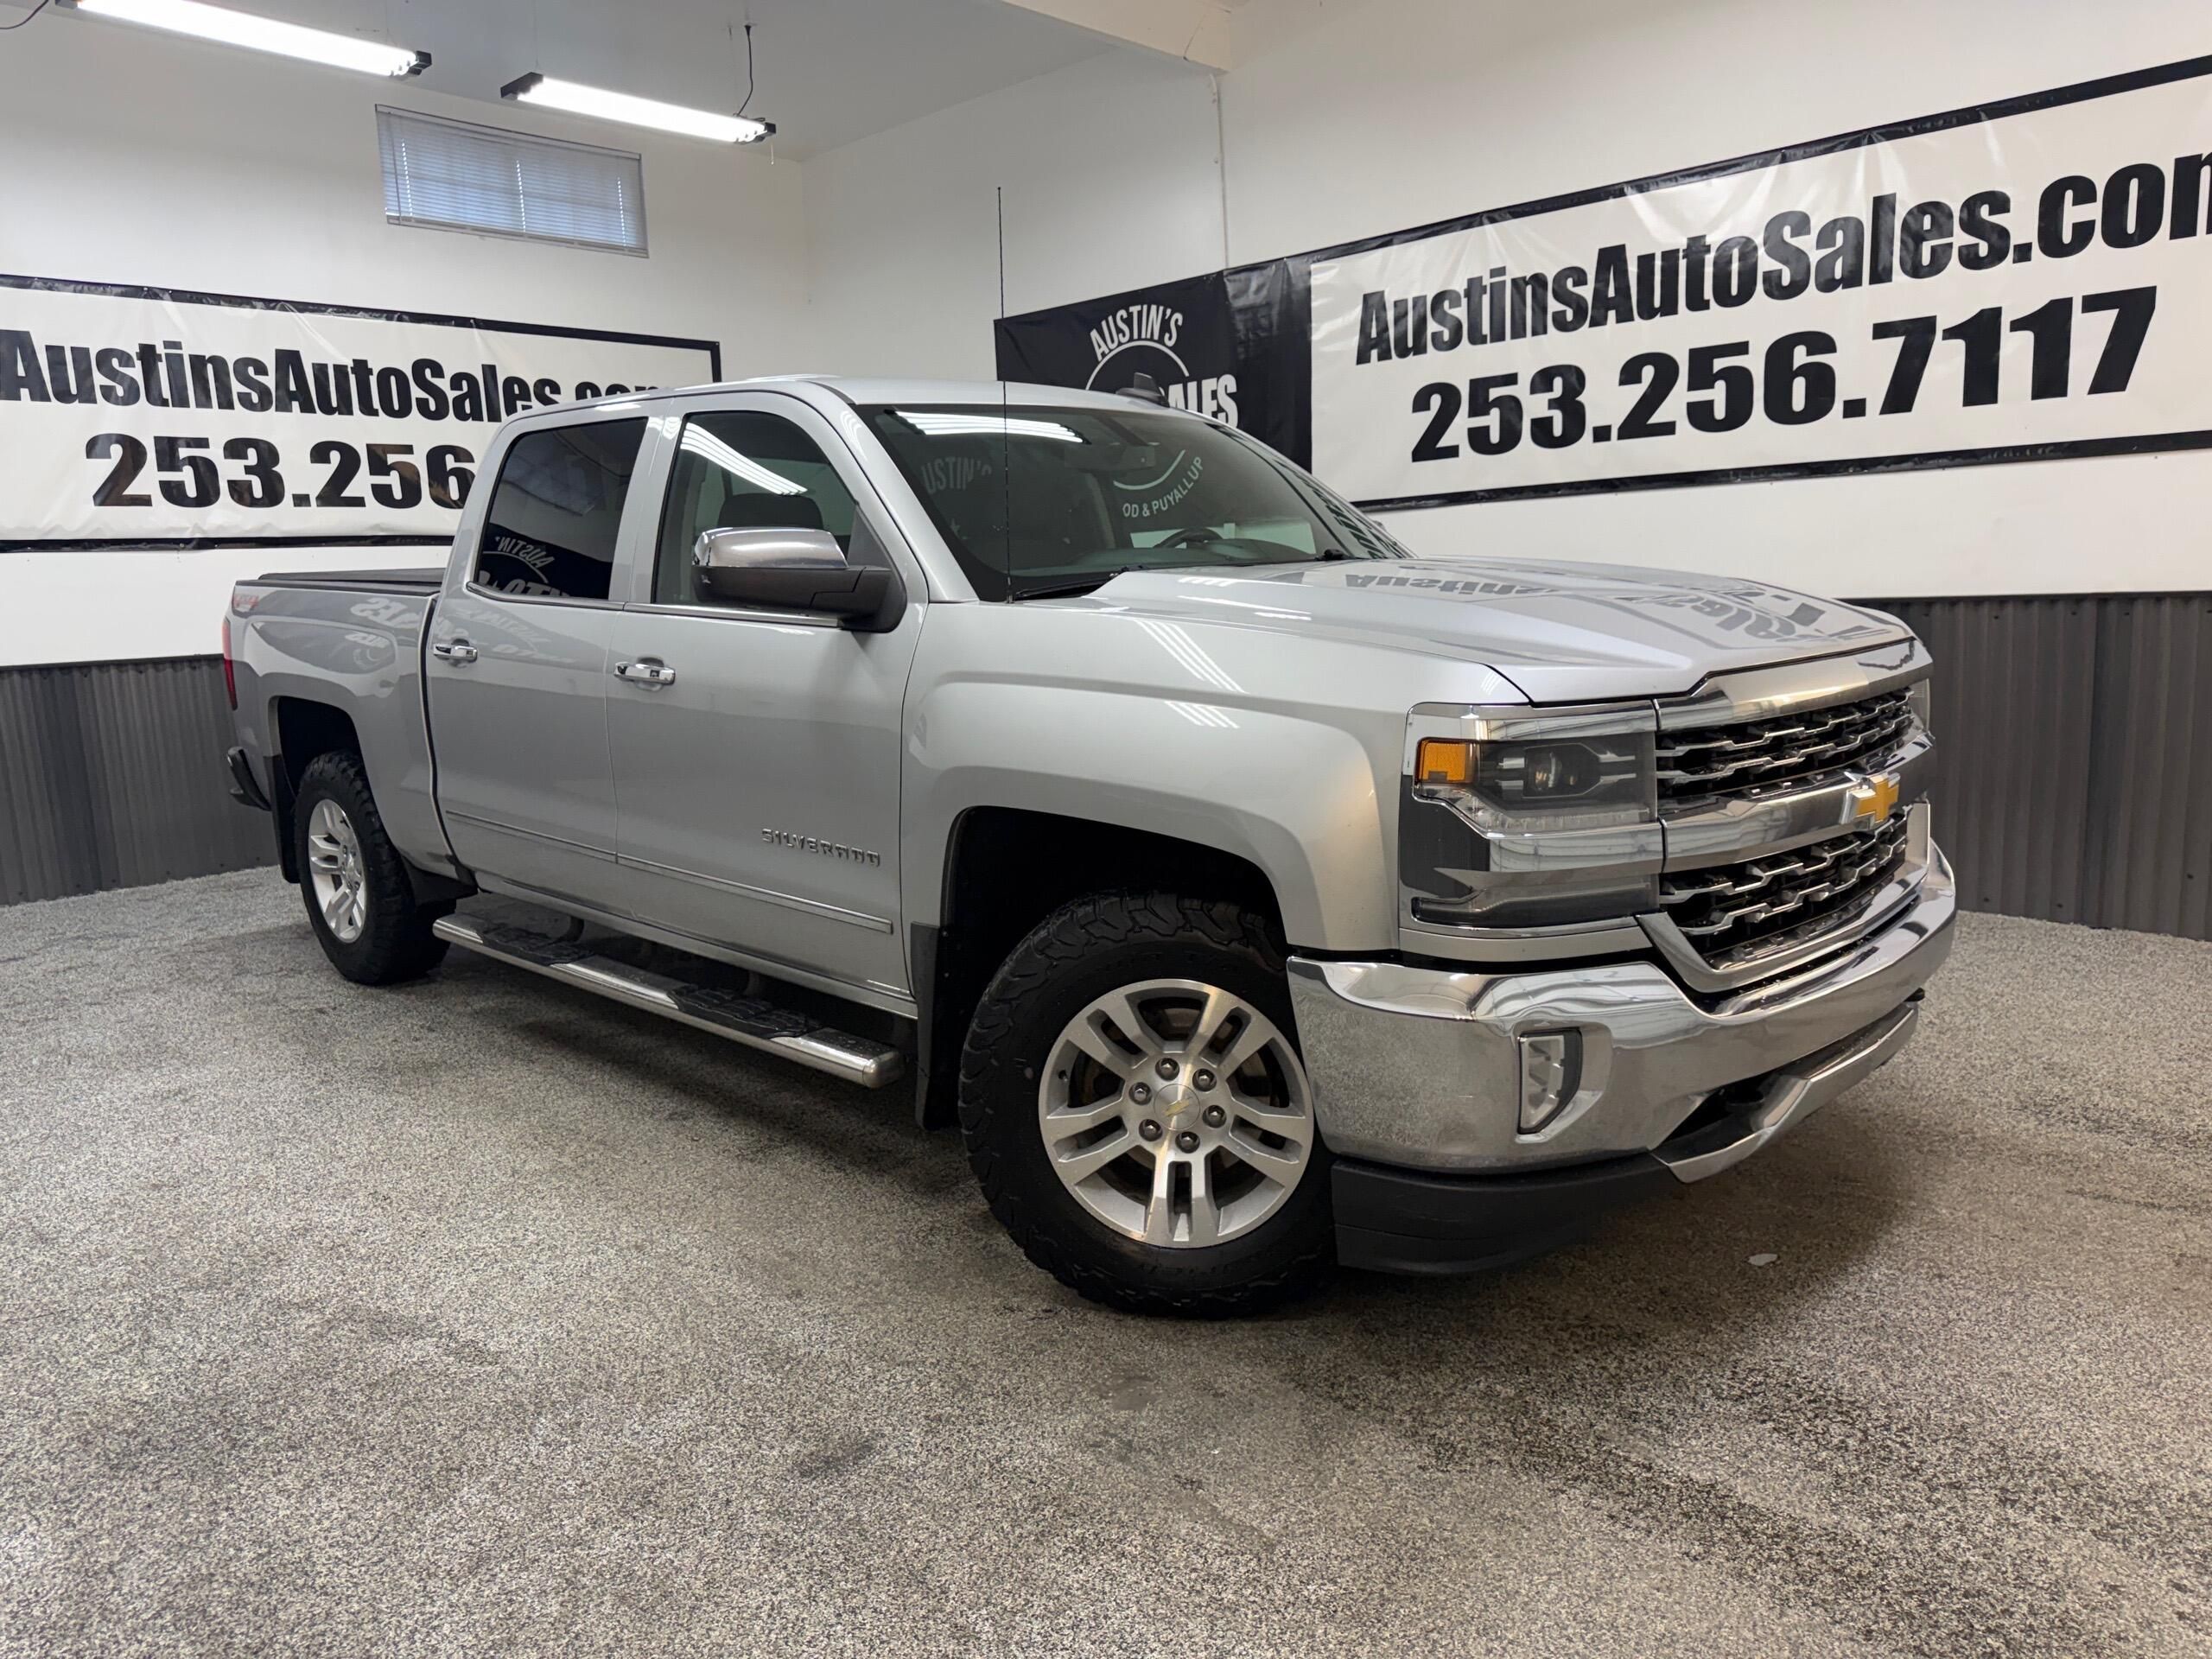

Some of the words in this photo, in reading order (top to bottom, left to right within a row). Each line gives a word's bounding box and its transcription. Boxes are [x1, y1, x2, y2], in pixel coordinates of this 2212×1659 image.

[1090, 304, 1184, 362] AUSTIN'S
[0, 329, 658, 423] AustinsAutoSales
[1412, 285, 2158, 463] 253.256.7117
[1142, 503, 1151, 517] &
[1152, 456, 1204, 514] PUYALLUP
[761, 828, 881, 868] SILVERADO
